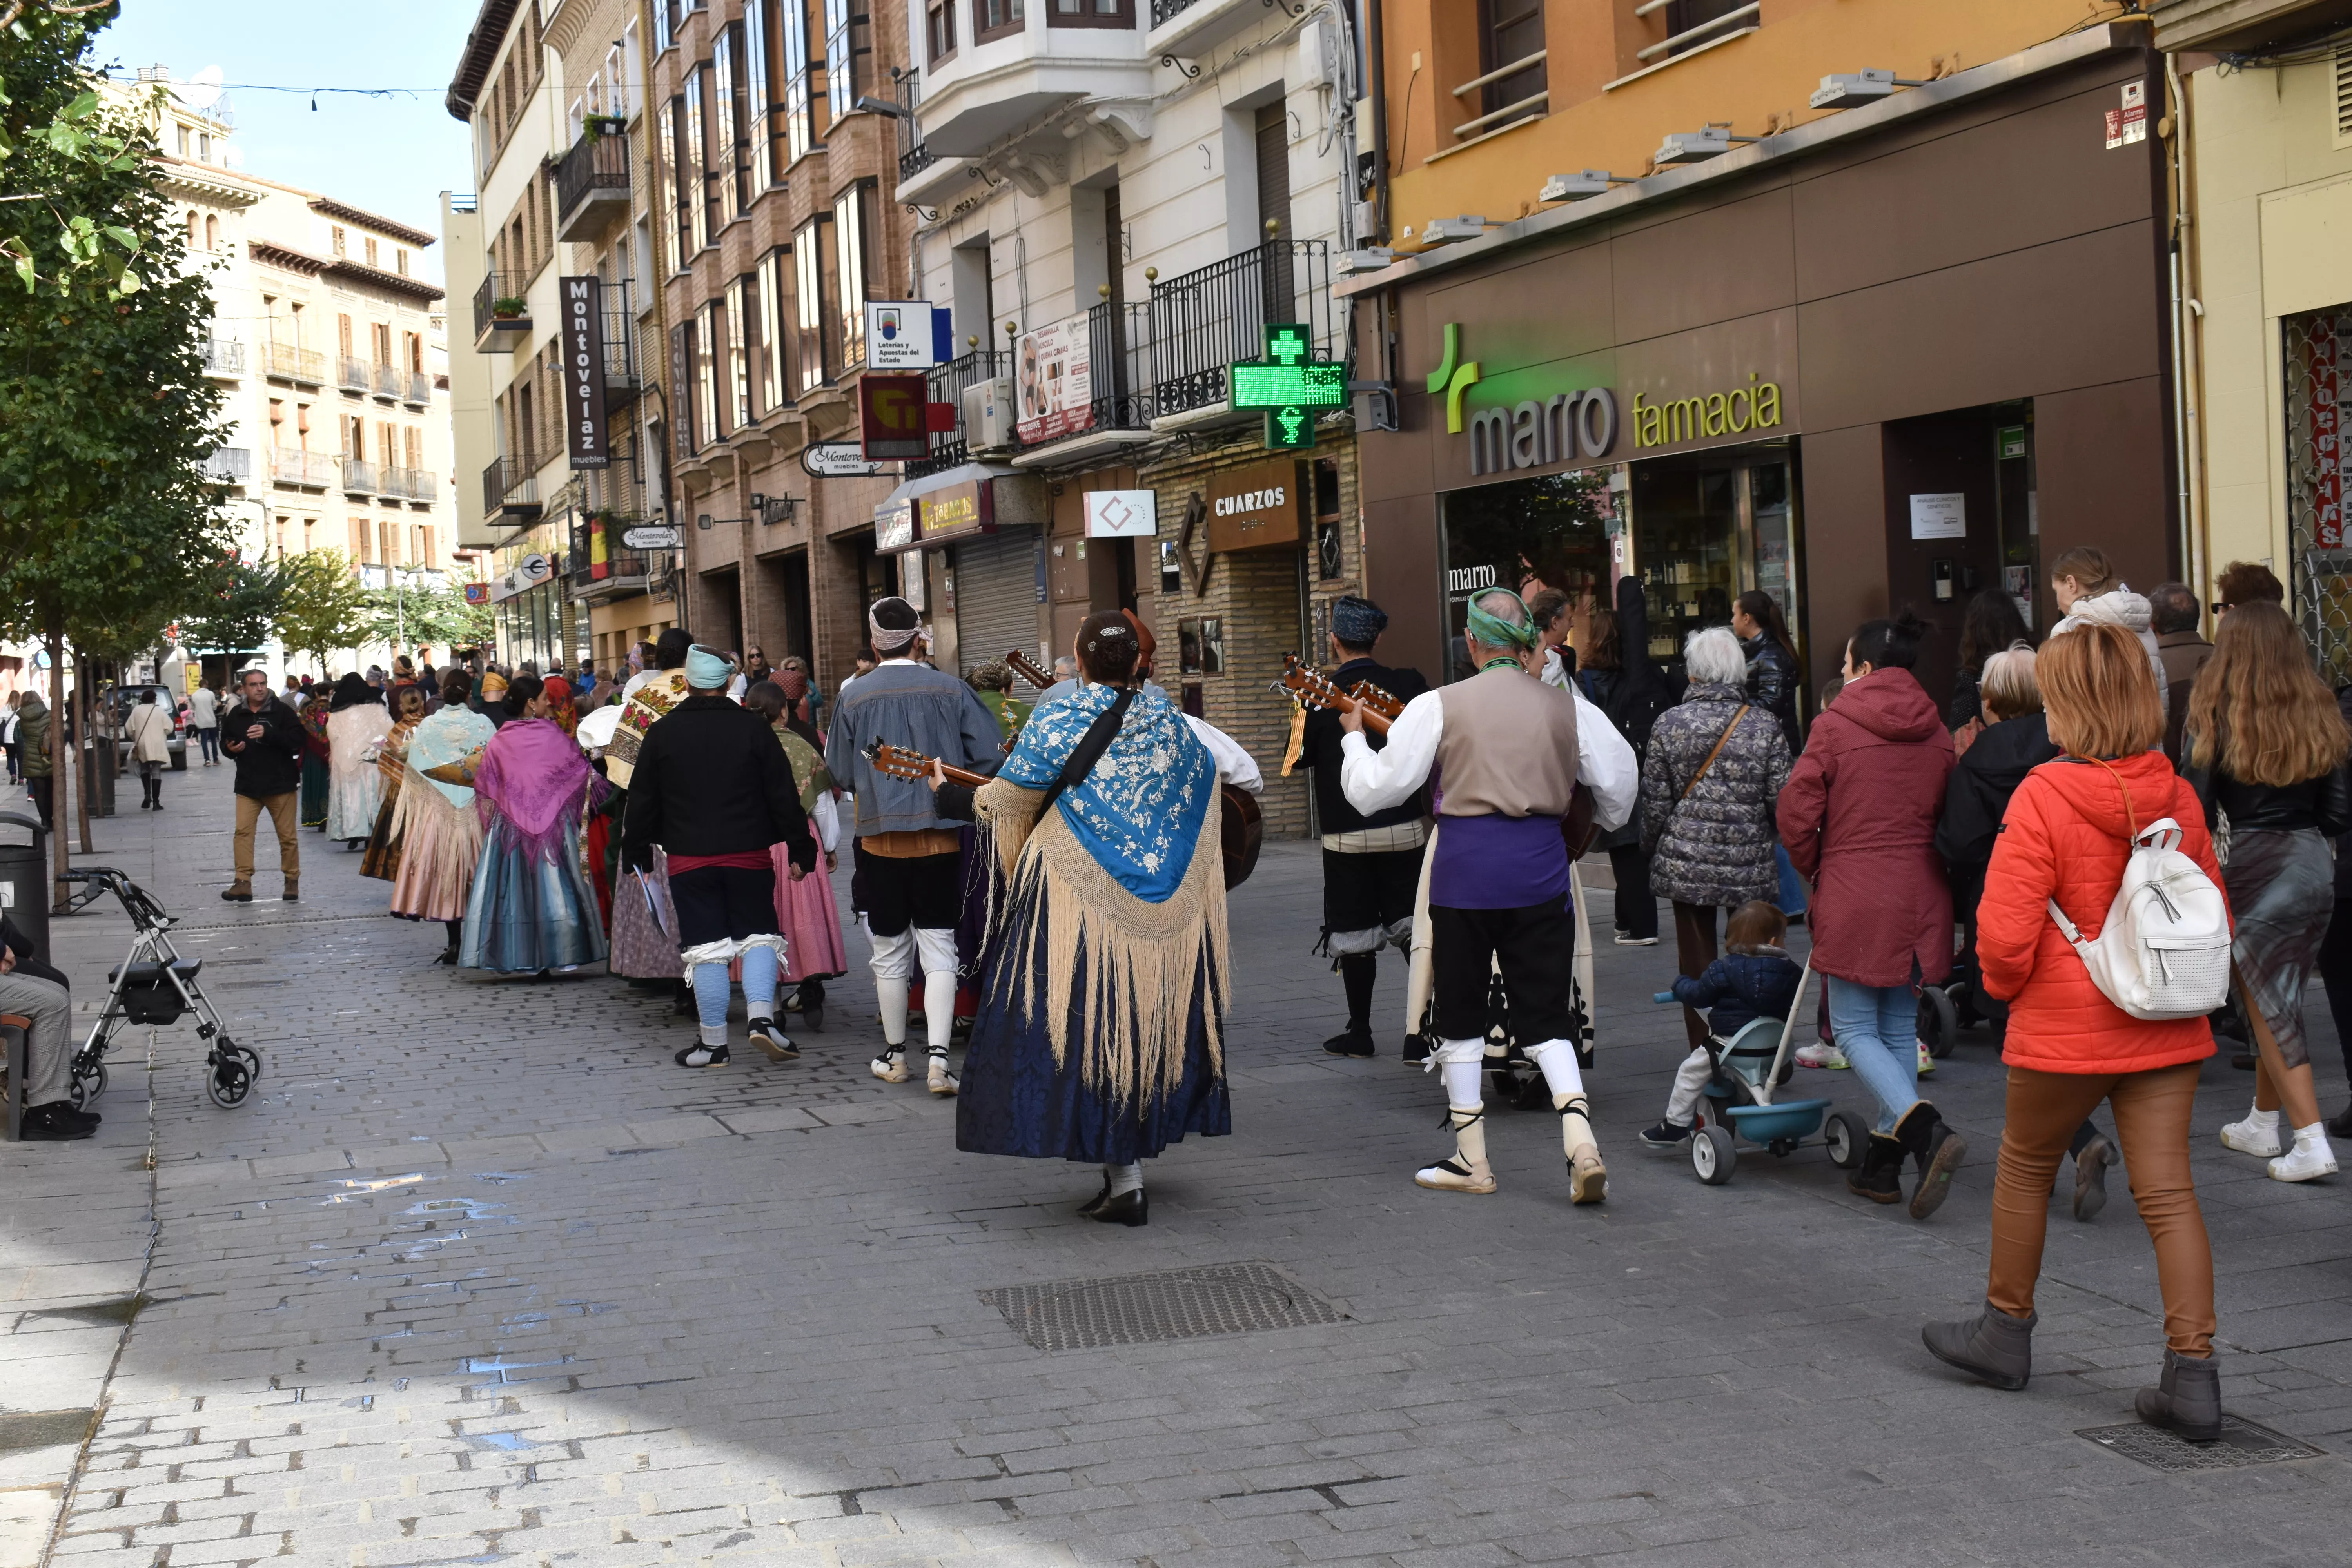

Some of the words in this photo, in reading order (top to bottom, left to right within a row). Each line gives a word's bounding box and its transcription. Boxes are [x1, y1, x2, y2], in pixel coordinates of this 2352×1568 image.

[2124, 108, 2144, 118] Alarma
[1037, 325, 1059, 339] DESARROLLA
[570, 282, 594, 449] Montovelaz
[1470, 387, 1617, 475] marro
[1632, 372, 1781, 447] farmacia
[2316, 319, 2337, 544] FOTOCOPIAS
[815, 451, 862, 462] Montove
[1215, 486, 1285, 517] CUARZOS
[628, 531, 675, 541] Montovelaz
[1449, 564, 1495, 591] marro
